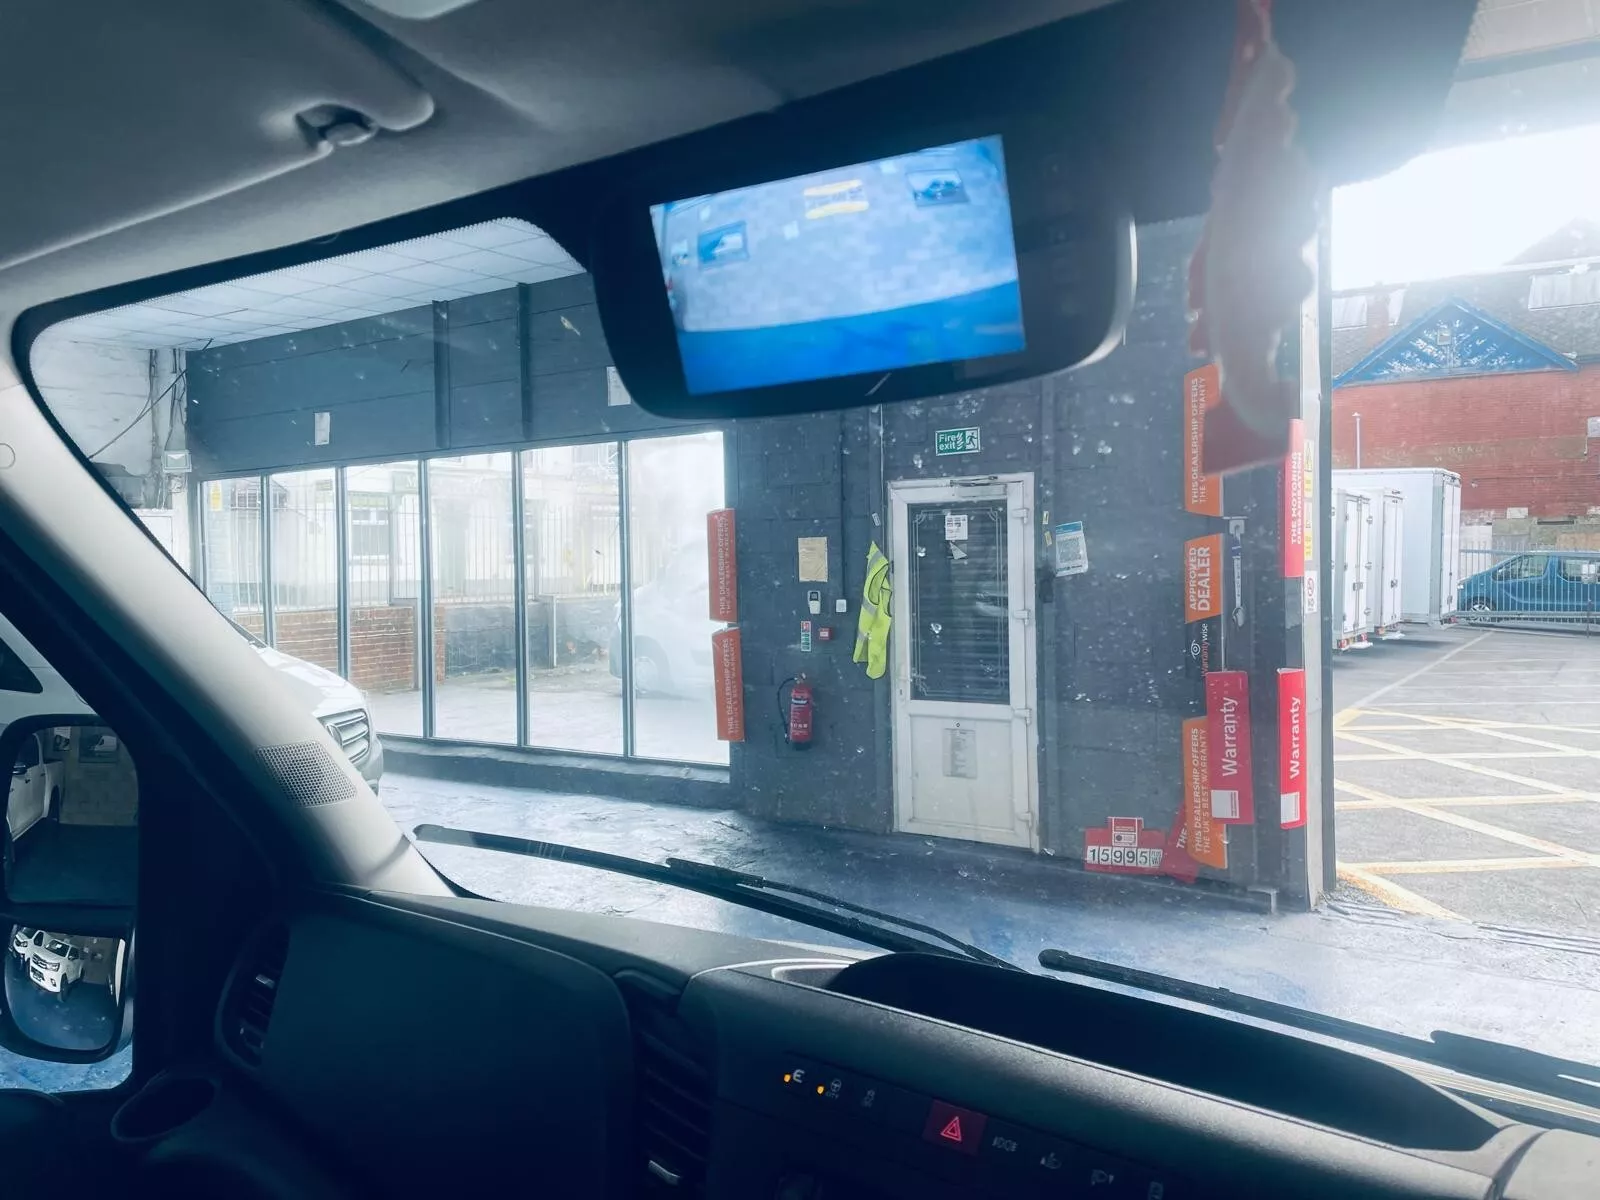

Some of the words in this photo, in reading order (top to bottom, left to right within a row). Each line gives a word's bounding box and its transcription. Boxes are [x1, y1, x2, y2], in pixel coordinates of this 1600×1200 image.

[1191, 377, 1199, 416] OFFERS
[939, 434, 956, 443] Fire
[939, 442, 956, 450] exit
[1191, 418, 1199, 480] DEALERSHIP
[1191, 481, 1199, 505] THIS
[1199, 485, 1207, 504] THE
[1189, 547, 1197, 610] APPROVED
[1198, 546, 1210, 611] DEALER
[722, 638, 730, 668] OFFERS
[1200, 623, 1210, 676] Warrantywise
[724, 669, 733, 715] DEALERSHIP
[1191, 727, 1199, 767] OFFERS
[1200, 727, 1208, 783] WARRANTY
[1220, 696, 1239, 777] Warranty
[1289, 696, 1301, 779] Warranty
[1193, 767, 1202, 829] DEALERSHIP
[1201, 785, 1209, 809] BEST
[1089, 849, 1148, 866] 15995
[1175, 827, 1188, 849] THE
[1195, 830, 1203, 853] THIS
